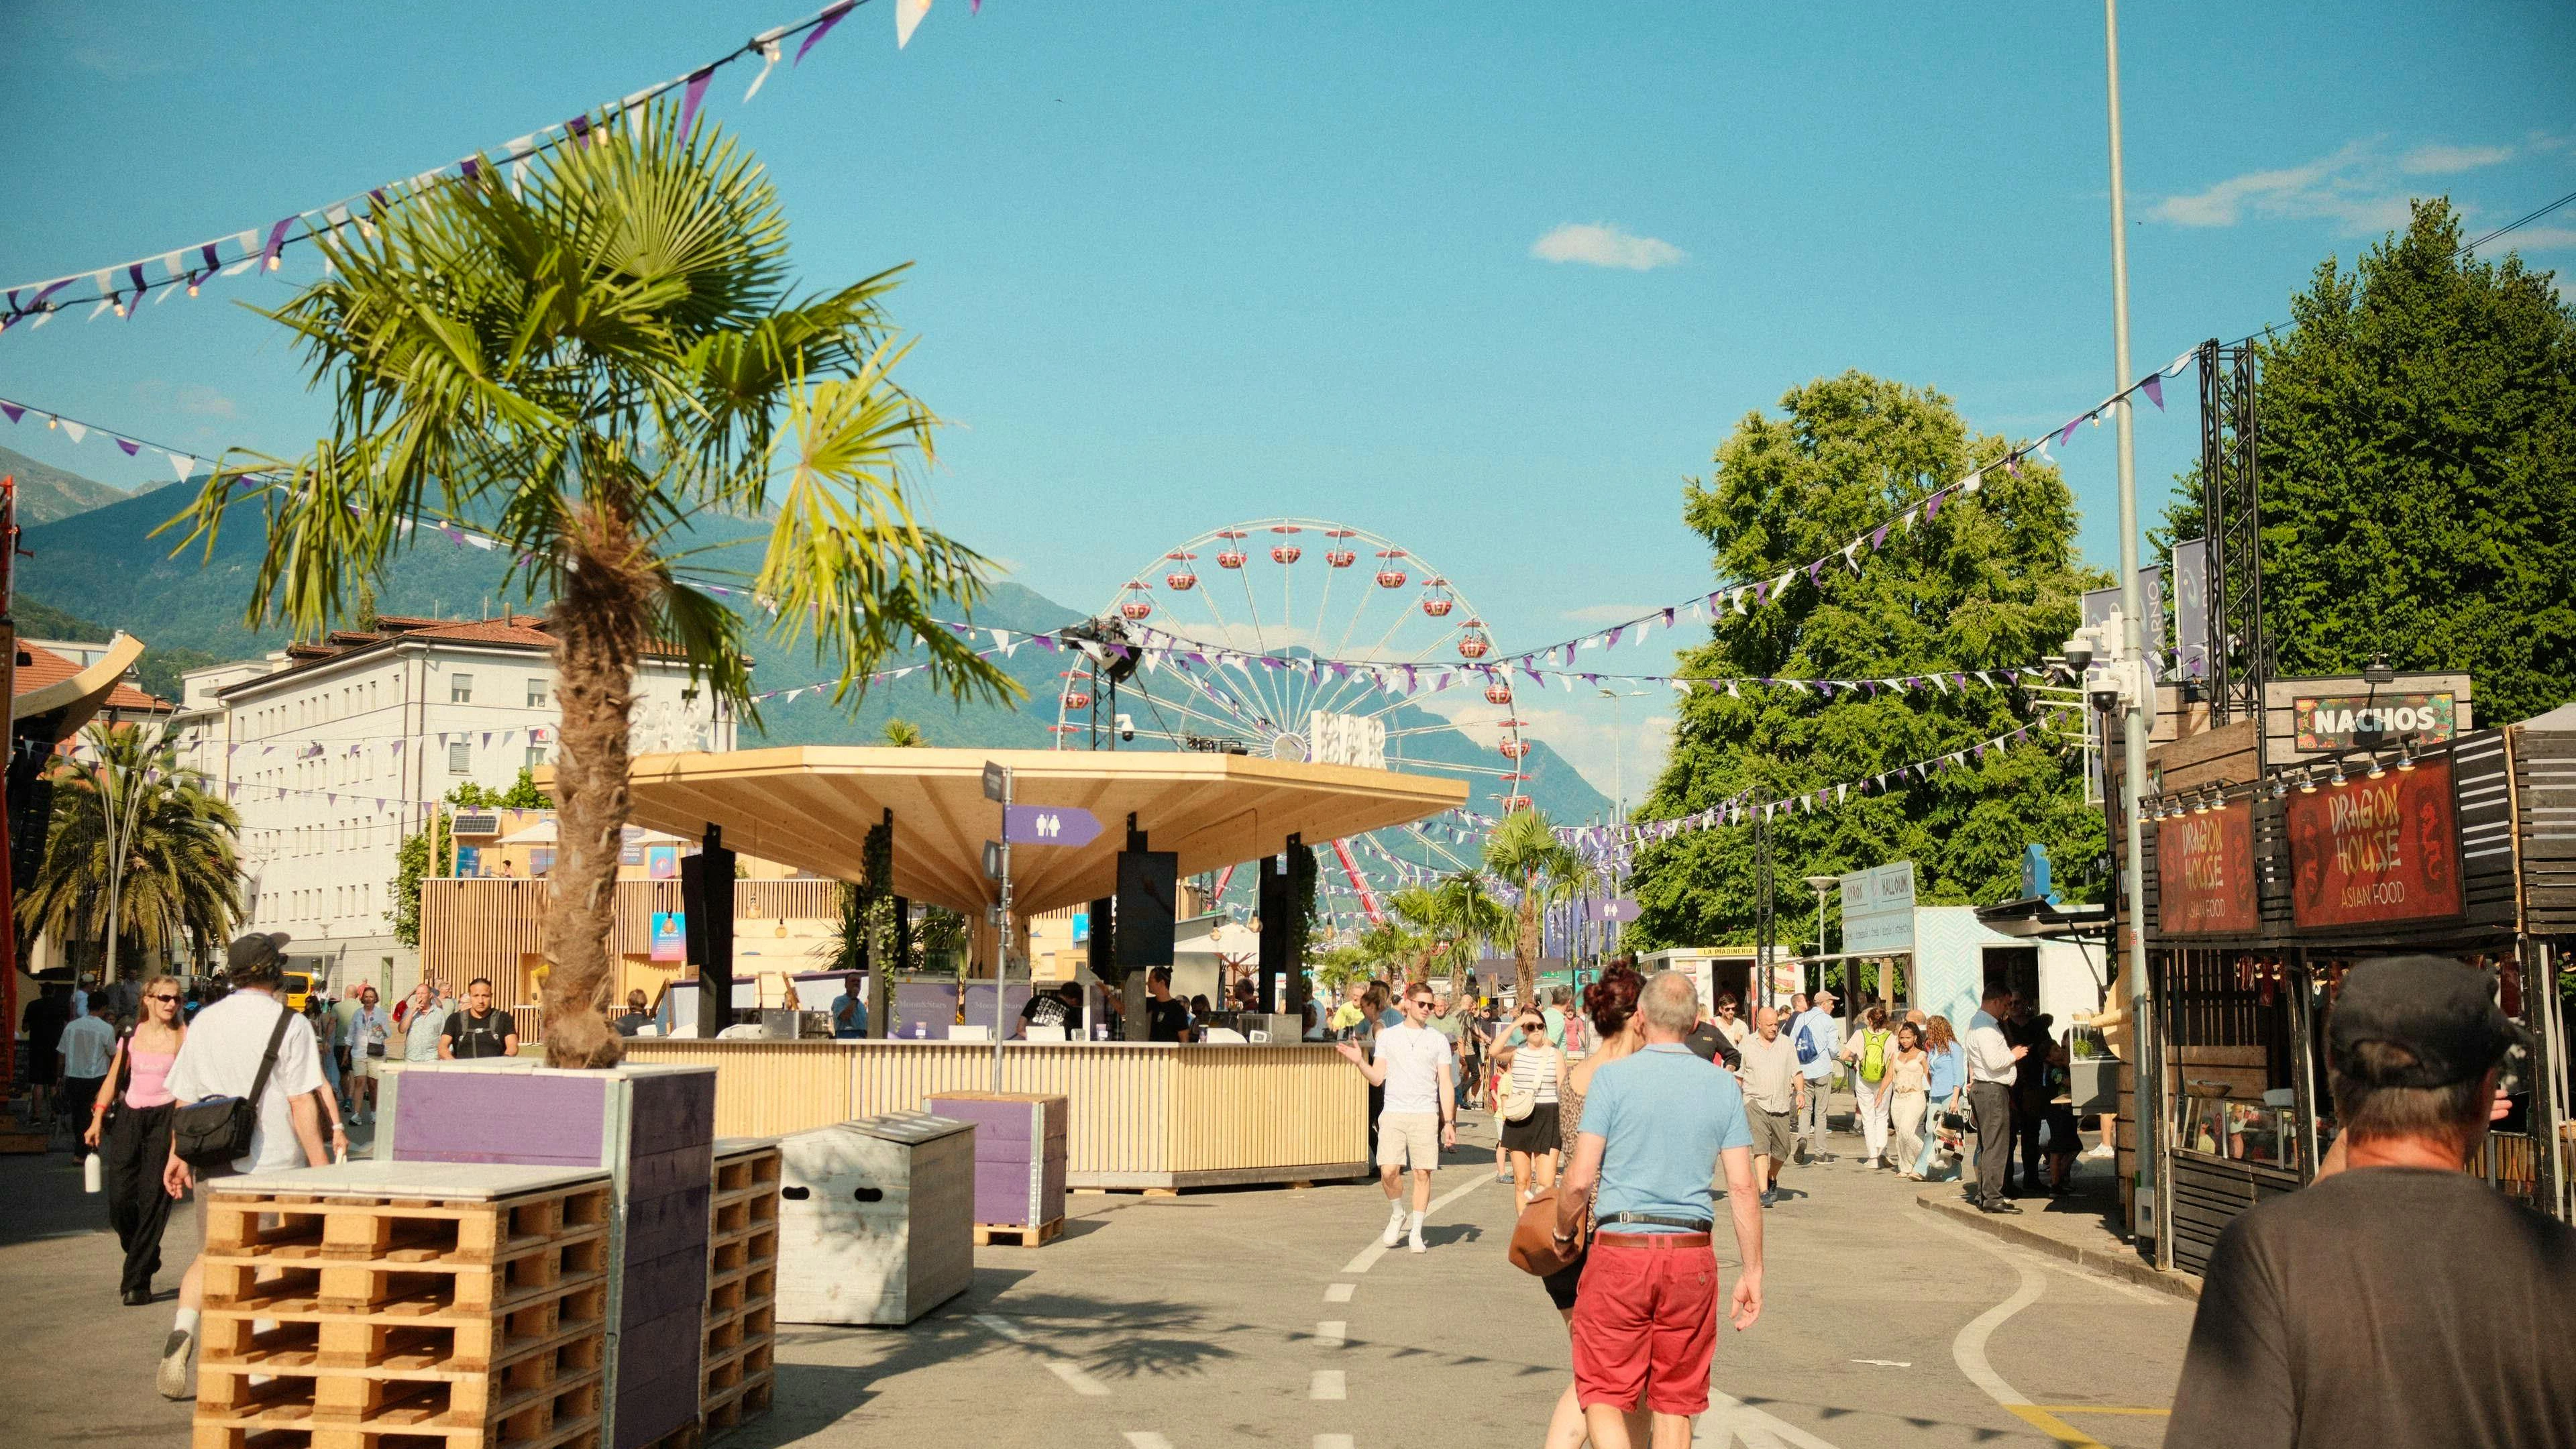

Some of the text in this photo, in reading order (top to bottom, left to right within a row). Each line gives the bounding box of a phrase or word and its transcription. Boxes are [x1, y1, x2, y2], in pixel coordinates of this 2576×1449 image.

[2315, 706, 2436, 733] NACHOS
[1311, 710, 1388, 769] BAR
[2329, 783, 2400, 835] DRAGON
[2182, 817, 2223, 856] DRAGON
[2337, 828, 2402, 875] HOUSE
[2186, 854, 2224, 891] HOUSE
[1847, 882, 1863, 902] GYROS
[2188, 899, 2226, 918] ASIAN FOOD
[2341, 880, 2405, 909] ASIAN FOOD
